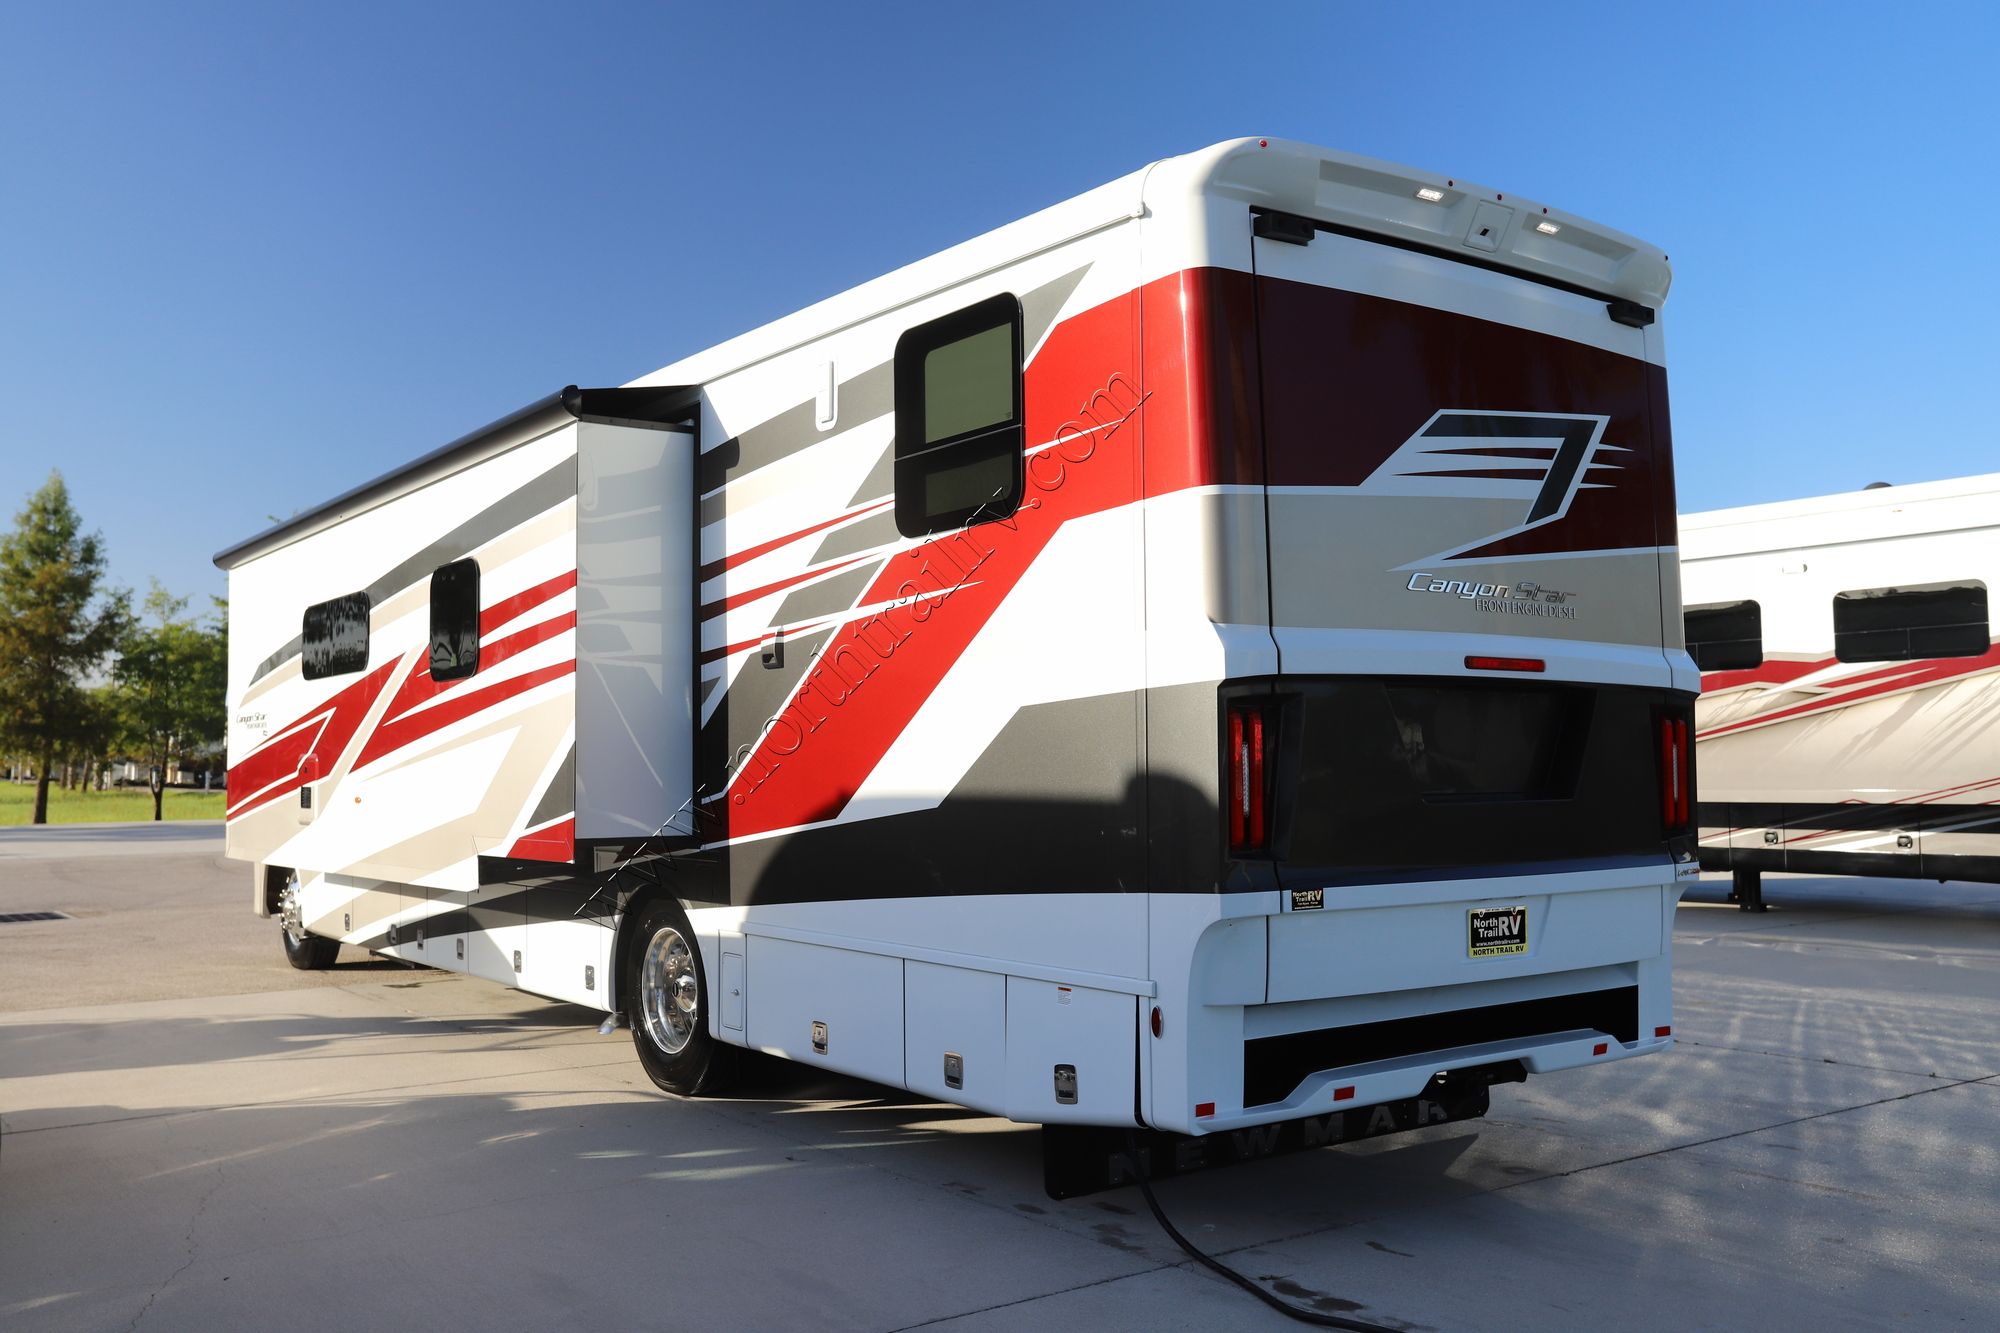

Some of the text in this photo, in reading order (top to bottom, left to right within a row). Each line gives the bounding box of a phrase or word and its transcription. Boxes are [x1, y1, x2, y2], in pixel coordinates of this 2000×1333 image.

[1407, 572, 1576, 604] Canyon Star
[1475, 599, 1510, 613] FRONT
[1511, 602, 1547, 617] ENGINE
[1308, 890, 1322, 901] RV
[1473, 918, 1498, 928] North
[1498, 915, 1522, 936] RV
[1478, 927, 1498, 938] Trail
[1473, 947, 1495, 956] NORTH
[1496, 945, 1514, 954] TRAIL
[1107, 1099, 1448, 1184] NEWMAR
